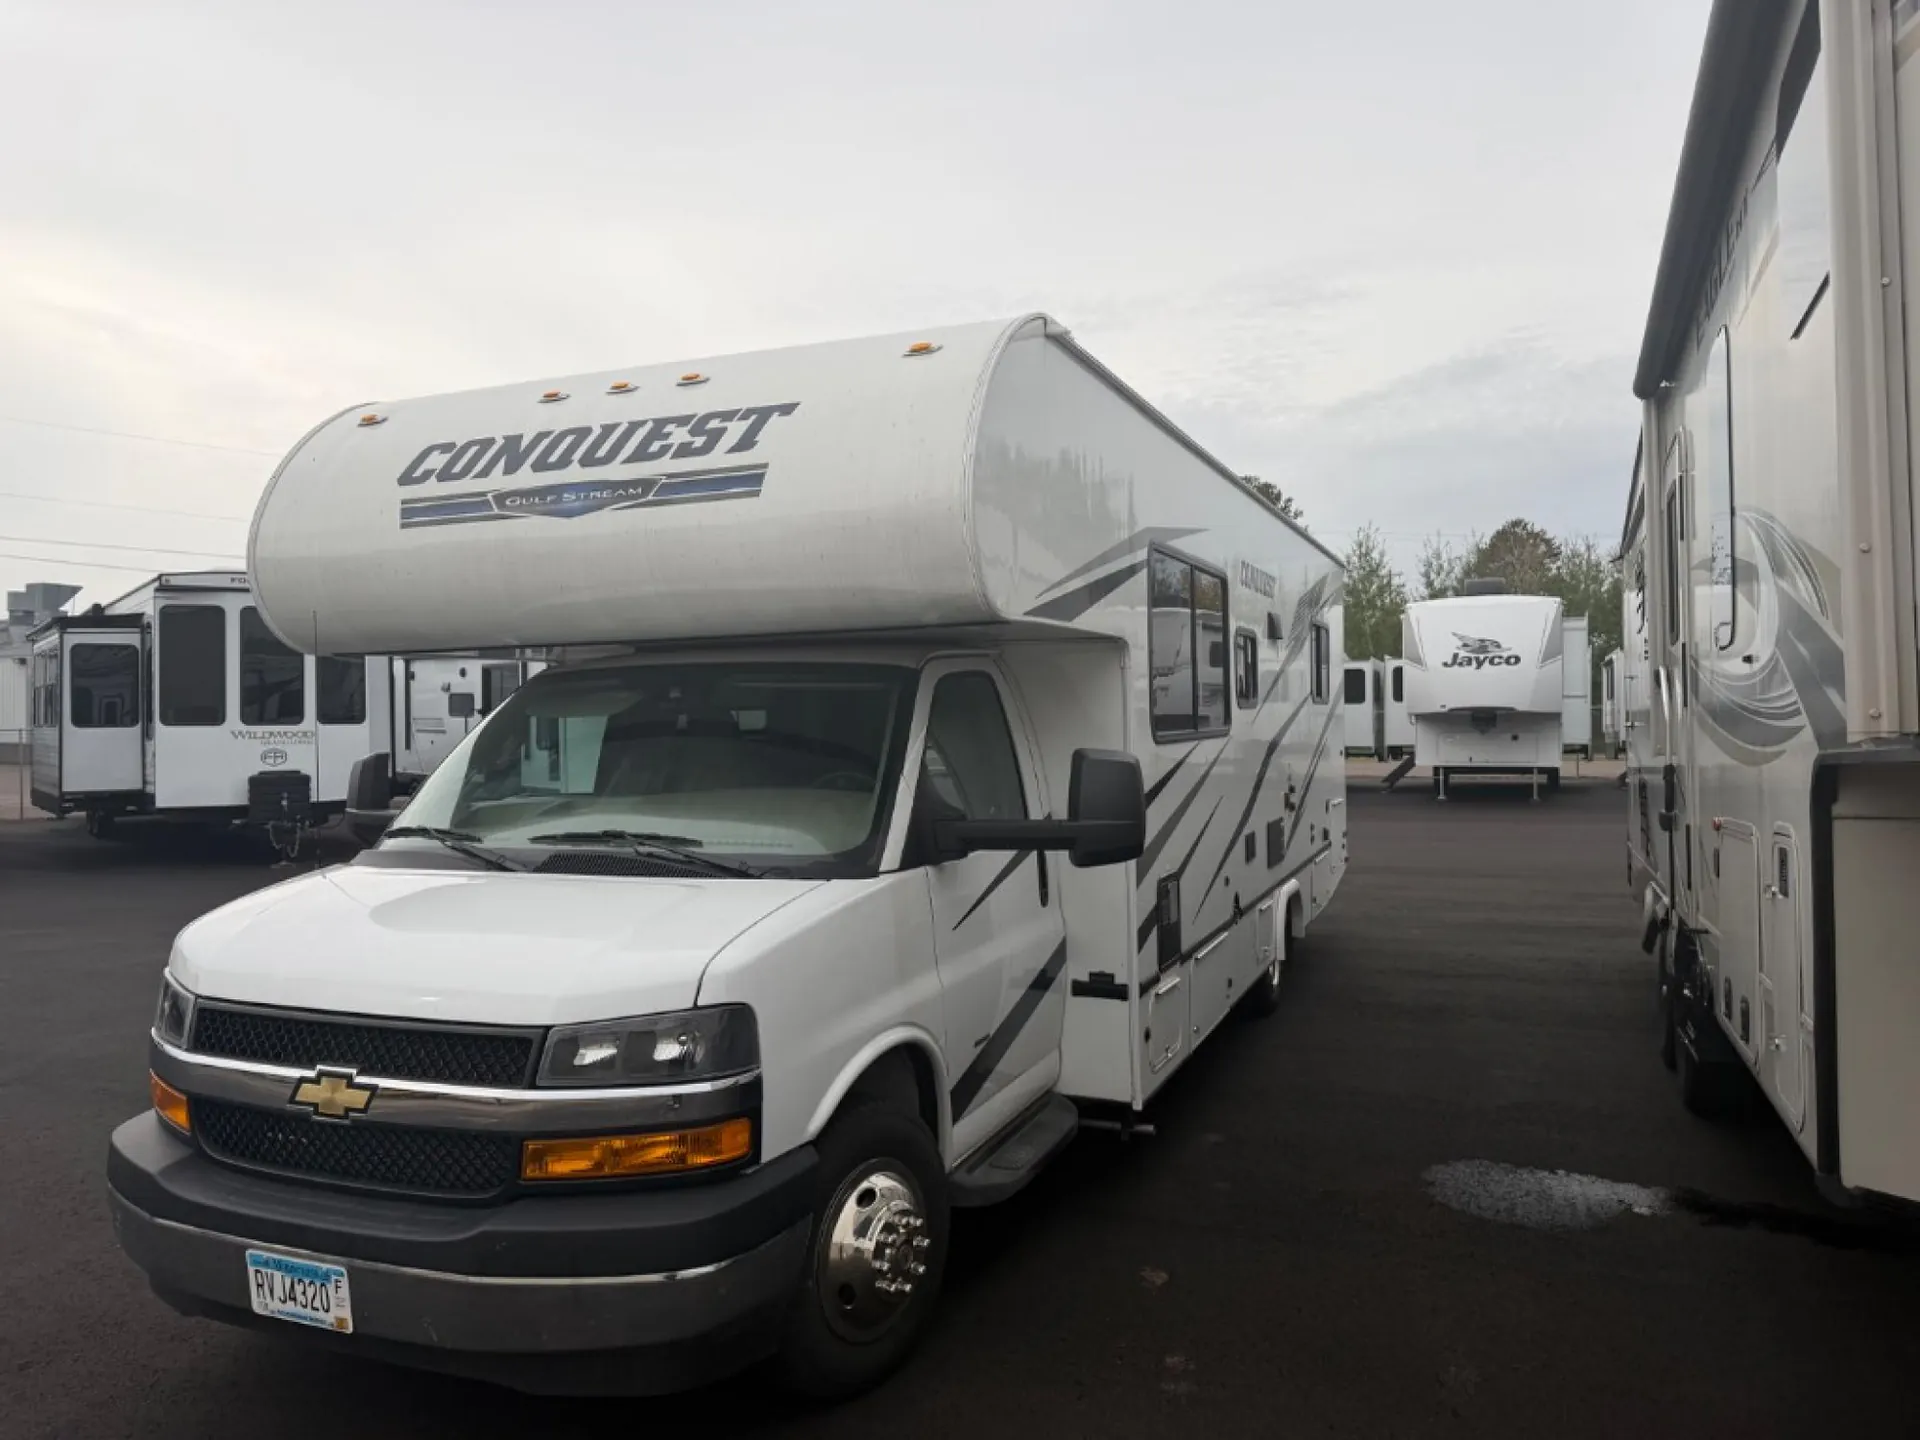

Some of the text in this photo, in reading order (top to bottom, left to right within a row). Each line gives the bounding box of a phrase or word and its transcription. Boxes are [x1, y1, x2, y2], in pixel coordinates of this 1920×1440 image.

[396, 401, 801, 487] CONQUEST
[505, 487, 642, 507] GULF STREAM
[1441, 652, 1522, 670] Jayco
[230, 730, 316, 740] WILDWOOD
[253, 1268, 331, 1314] RVJ4320
